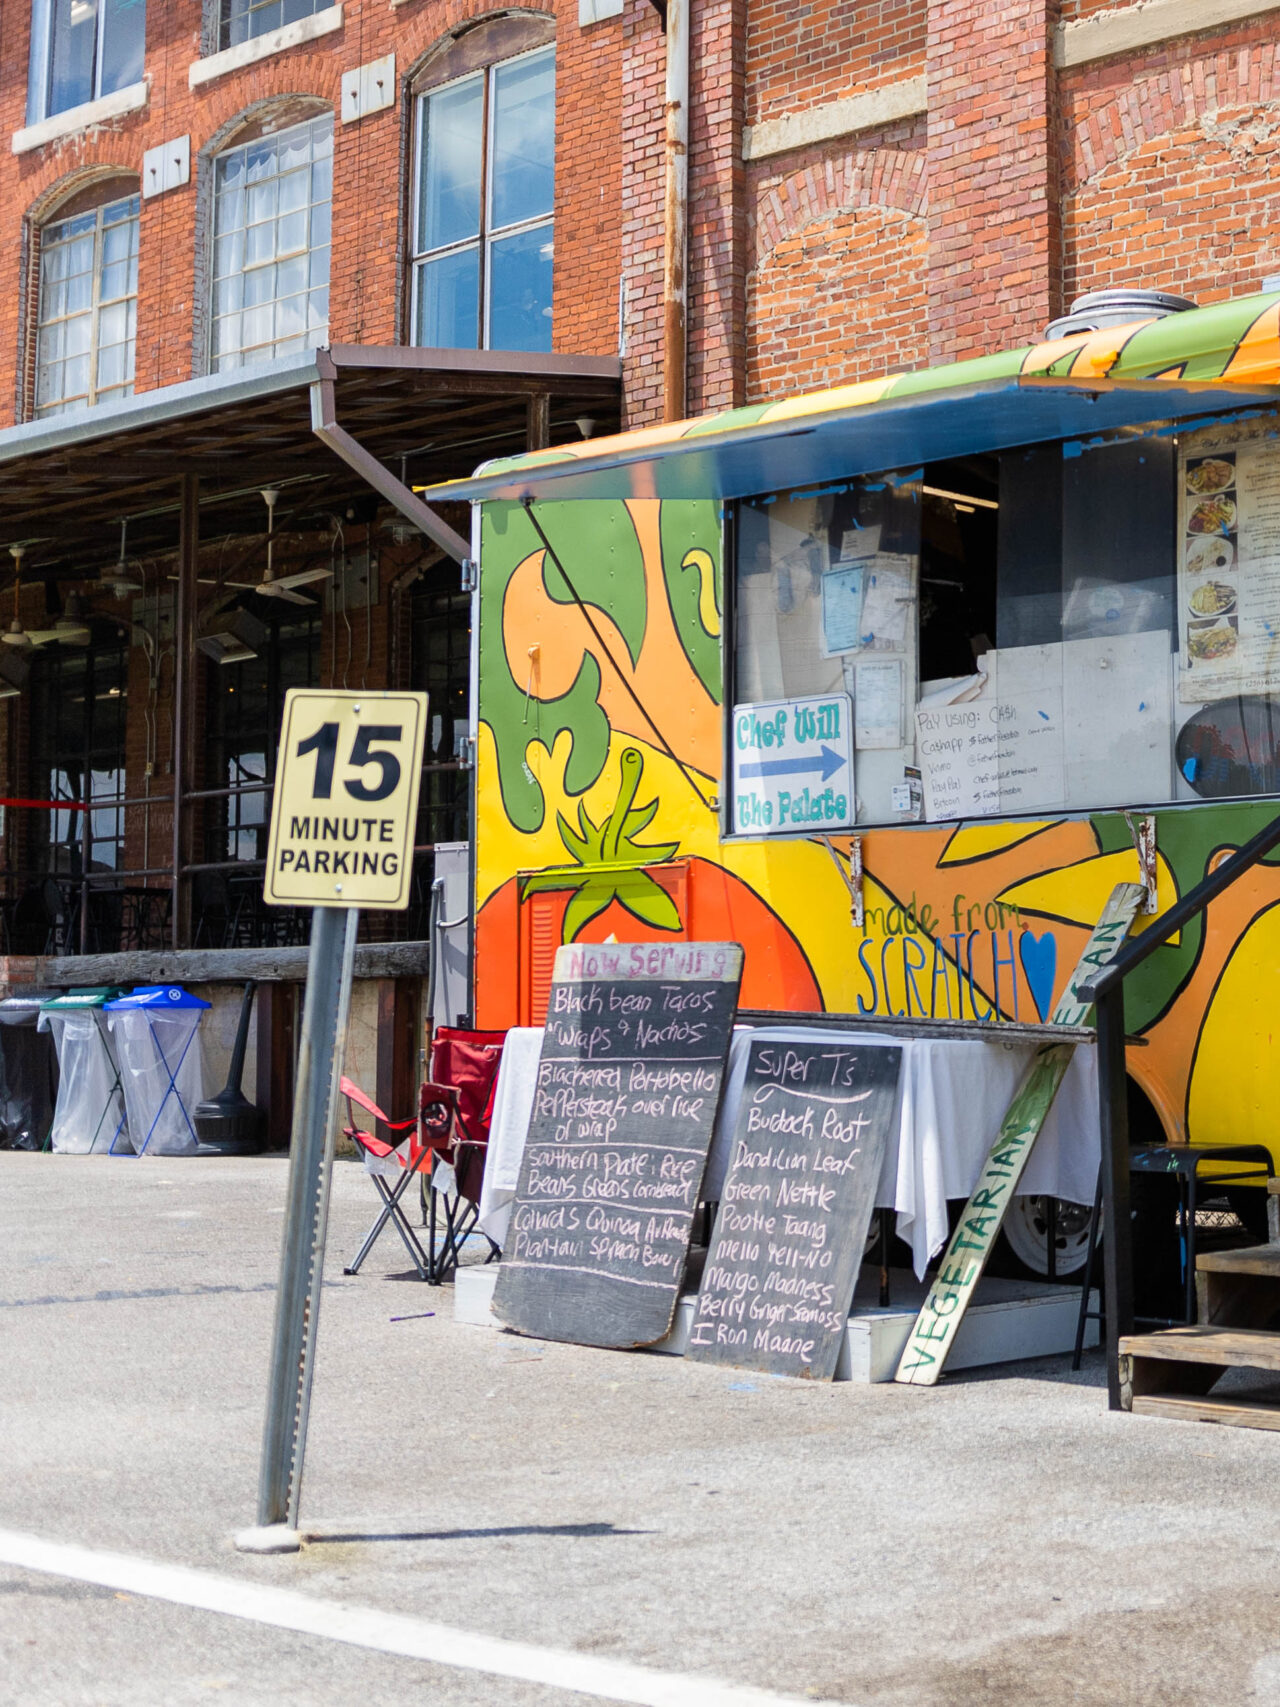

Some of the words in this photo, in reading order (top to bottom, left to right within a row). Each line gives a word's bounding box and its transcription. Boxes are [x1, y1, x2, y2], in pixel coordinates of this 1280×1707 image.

[736, 709, 788, 750] Chef
[794, 702, 841, 744] Will
[917, 711, 940, 733] Pay
[296, 721, 403, 802] 15
[737, 792, 774, 828] The
[778, 787, 847, 826] Palate
[290, 816, 395, 843] MINUTE
[279, 848, 399, 876] PARKING
[863, 891, 940, 937] made
[951, 893, 1023, 931] from
[857, 929, 1019, 1022] SCRATCH
[553, 984, 604, 1015] Black
[660, 985, 717, 1013] Tacos
[755, 1050, 817, 1085] Super
[821, 1108, 872, 1143] Root
[725, 1174, 771, 1201] Green
[903, 1122, 1033, 1371] VEGETARIAN
